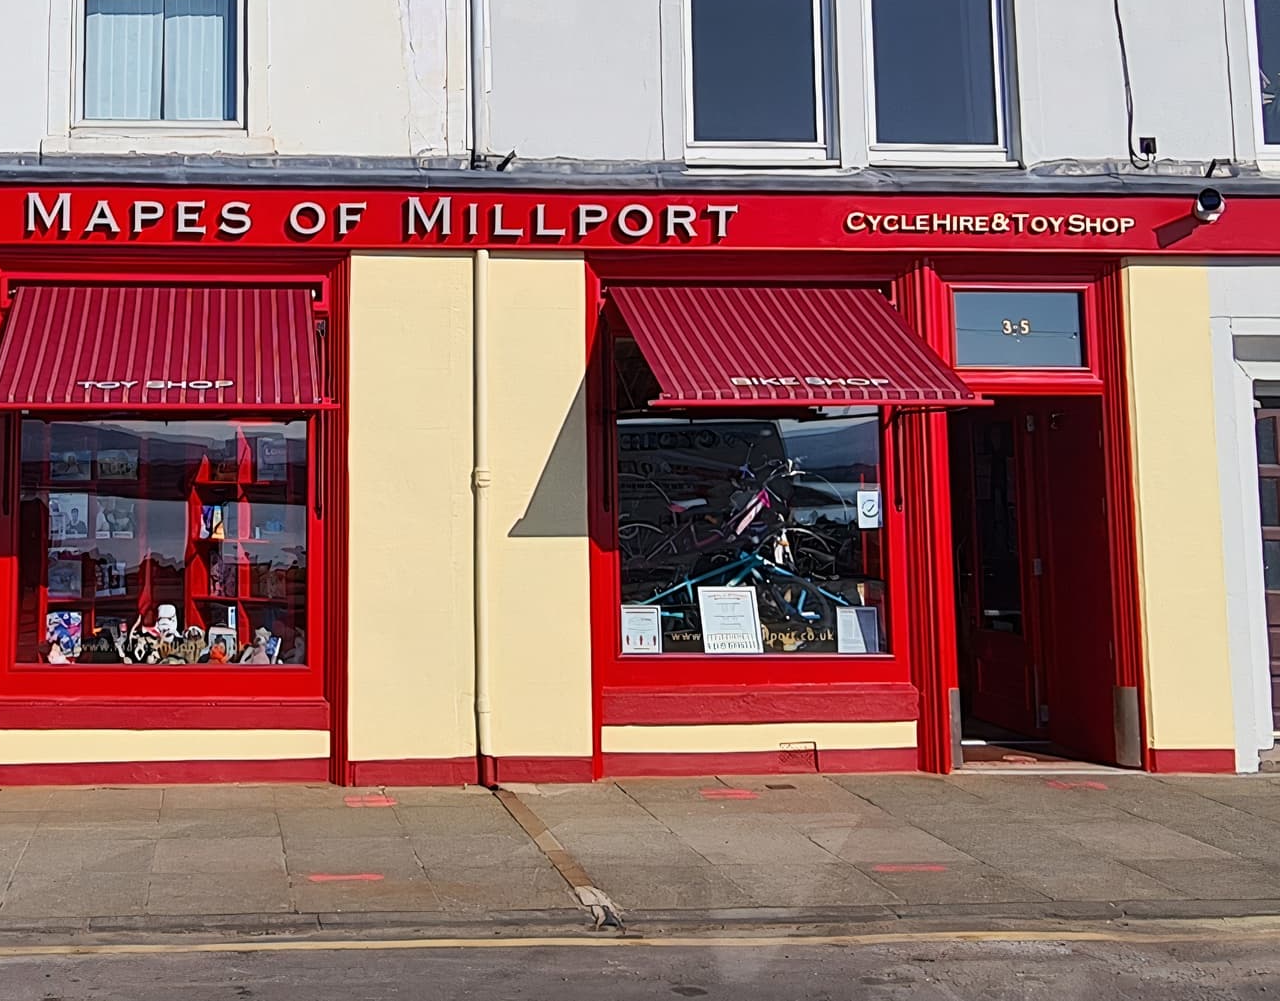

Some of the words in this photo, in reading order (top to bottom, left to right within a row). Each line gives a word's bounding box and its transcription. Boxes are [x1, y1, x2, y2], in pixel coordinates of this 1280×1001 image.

[26, 192, 252, 235] MAPES
[289, 201, 367, 235] OF
[407, 196, 738, 237] MILLPORT
[77, 380, 139, 389] TOY
[146, 380, 234, 389] SHOP
[731, 376, 801, 386] BIKE
[805, 376, 889, 386] SHOP
